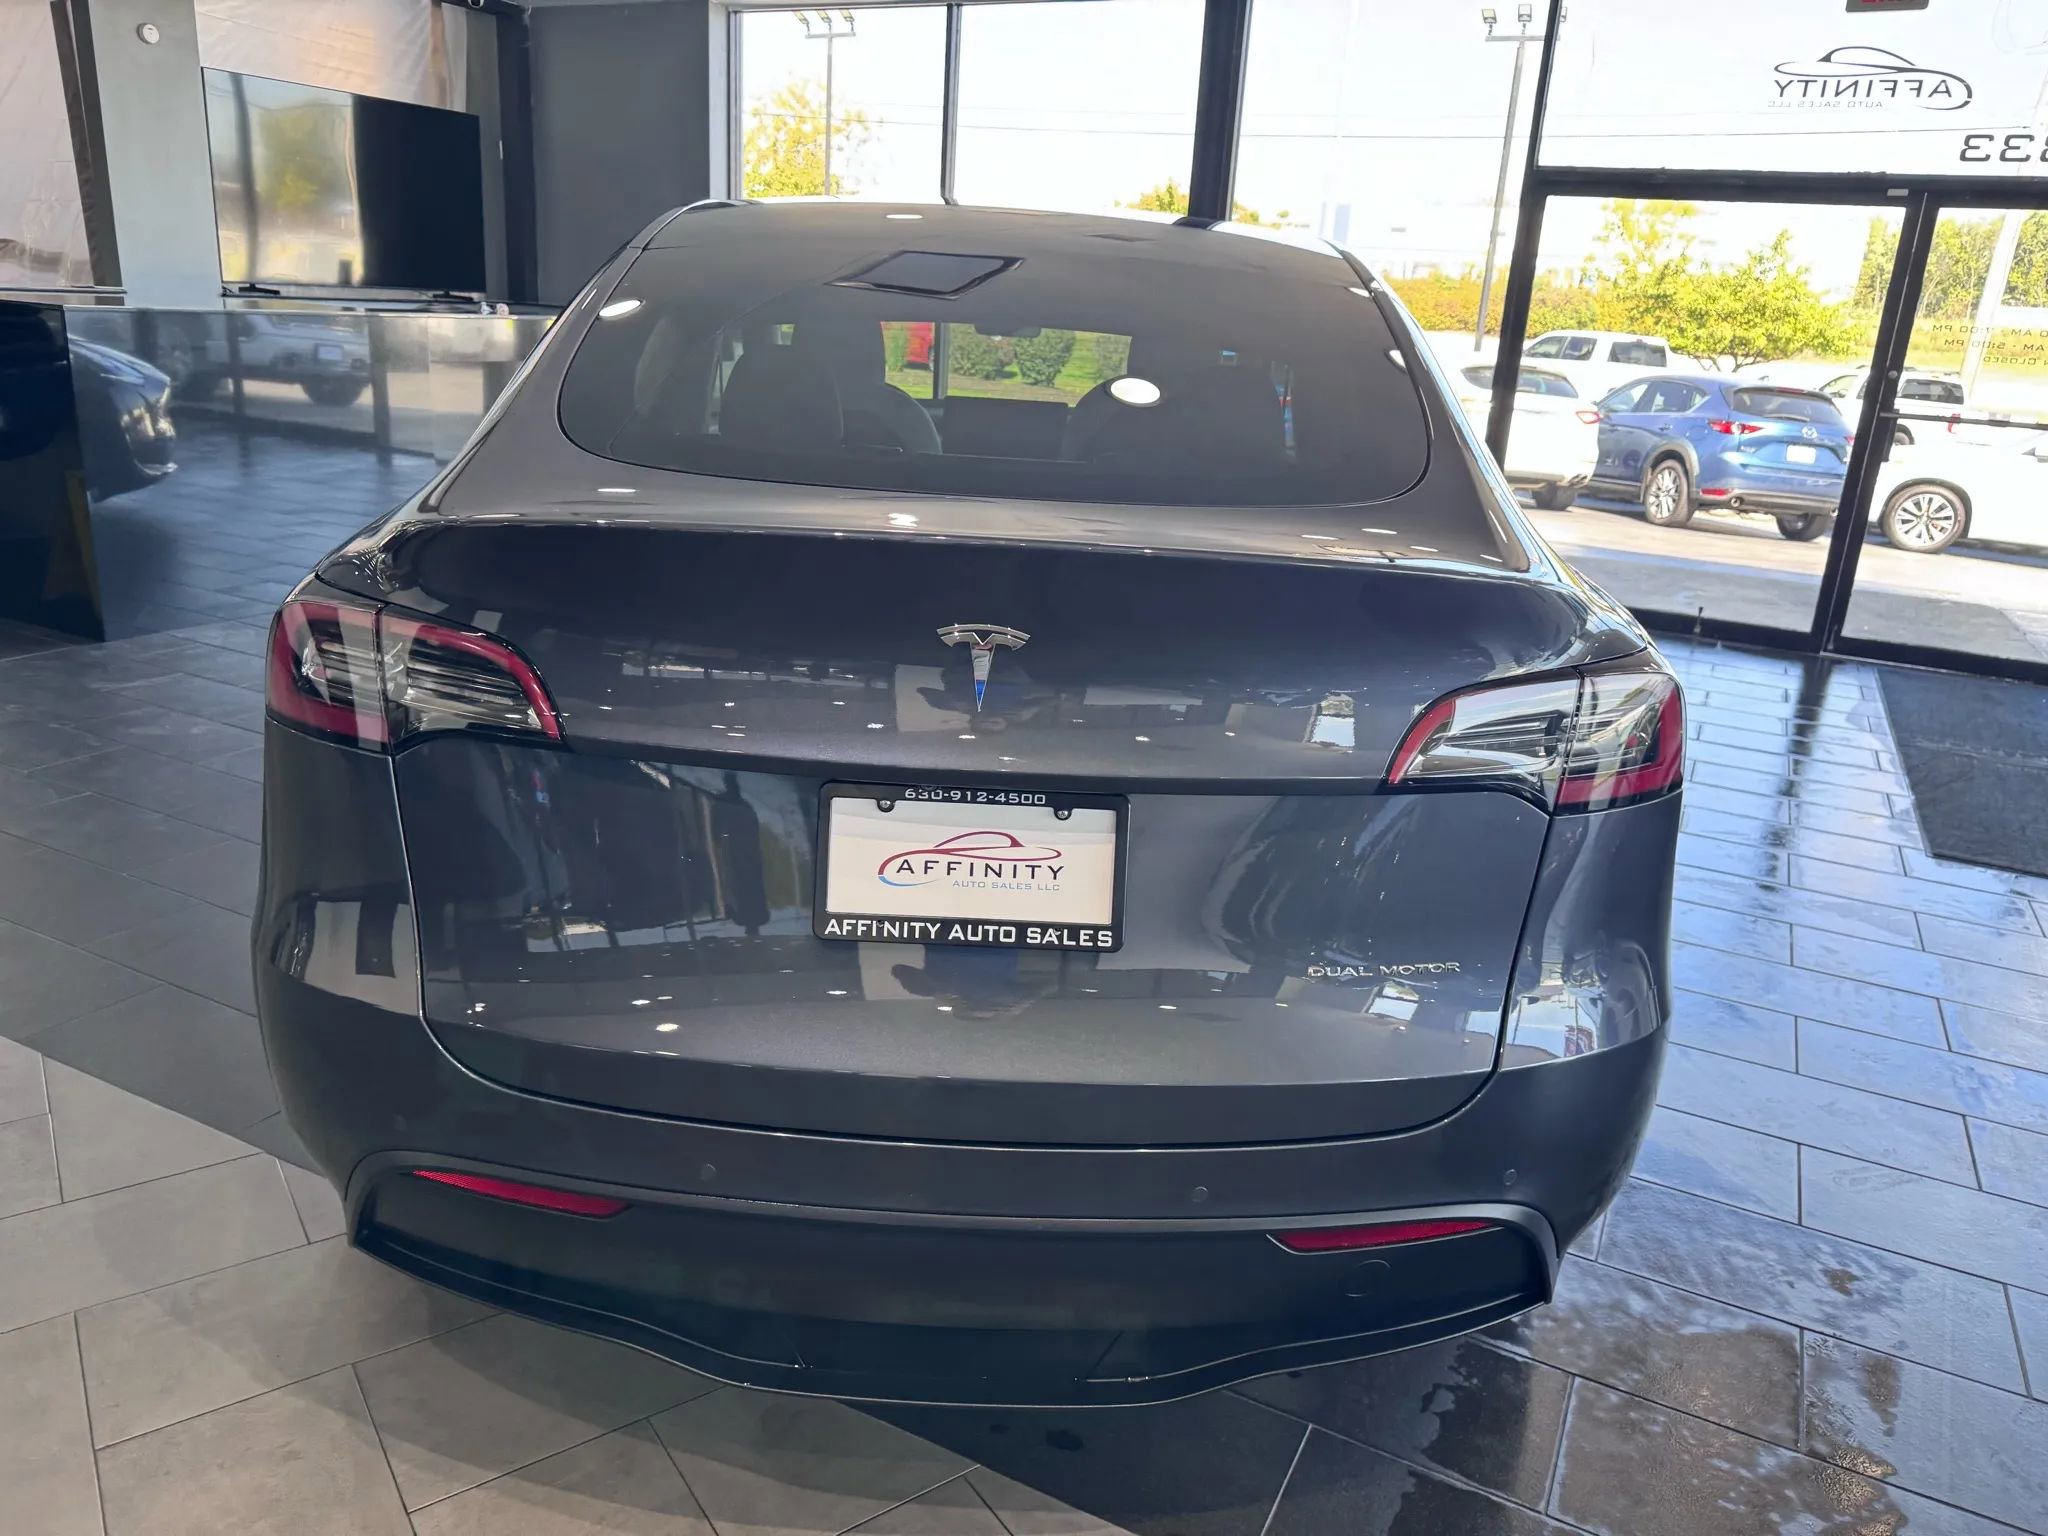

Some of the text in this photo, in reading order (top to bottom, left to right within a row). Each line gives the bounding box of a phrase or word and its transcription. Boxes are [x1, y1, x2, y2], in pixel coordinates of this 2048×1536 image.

[905, 788, 1046, 805] 630-912-4500
[896, 858, 1065, 880] AFFINITY
[952, 880, 1060, 891] AUTO SALES LLC
[824, 918, 1113, 947] AFFINITY AUTO SALES
[1307, 962, 1461, 977] DUAL MOTOR
